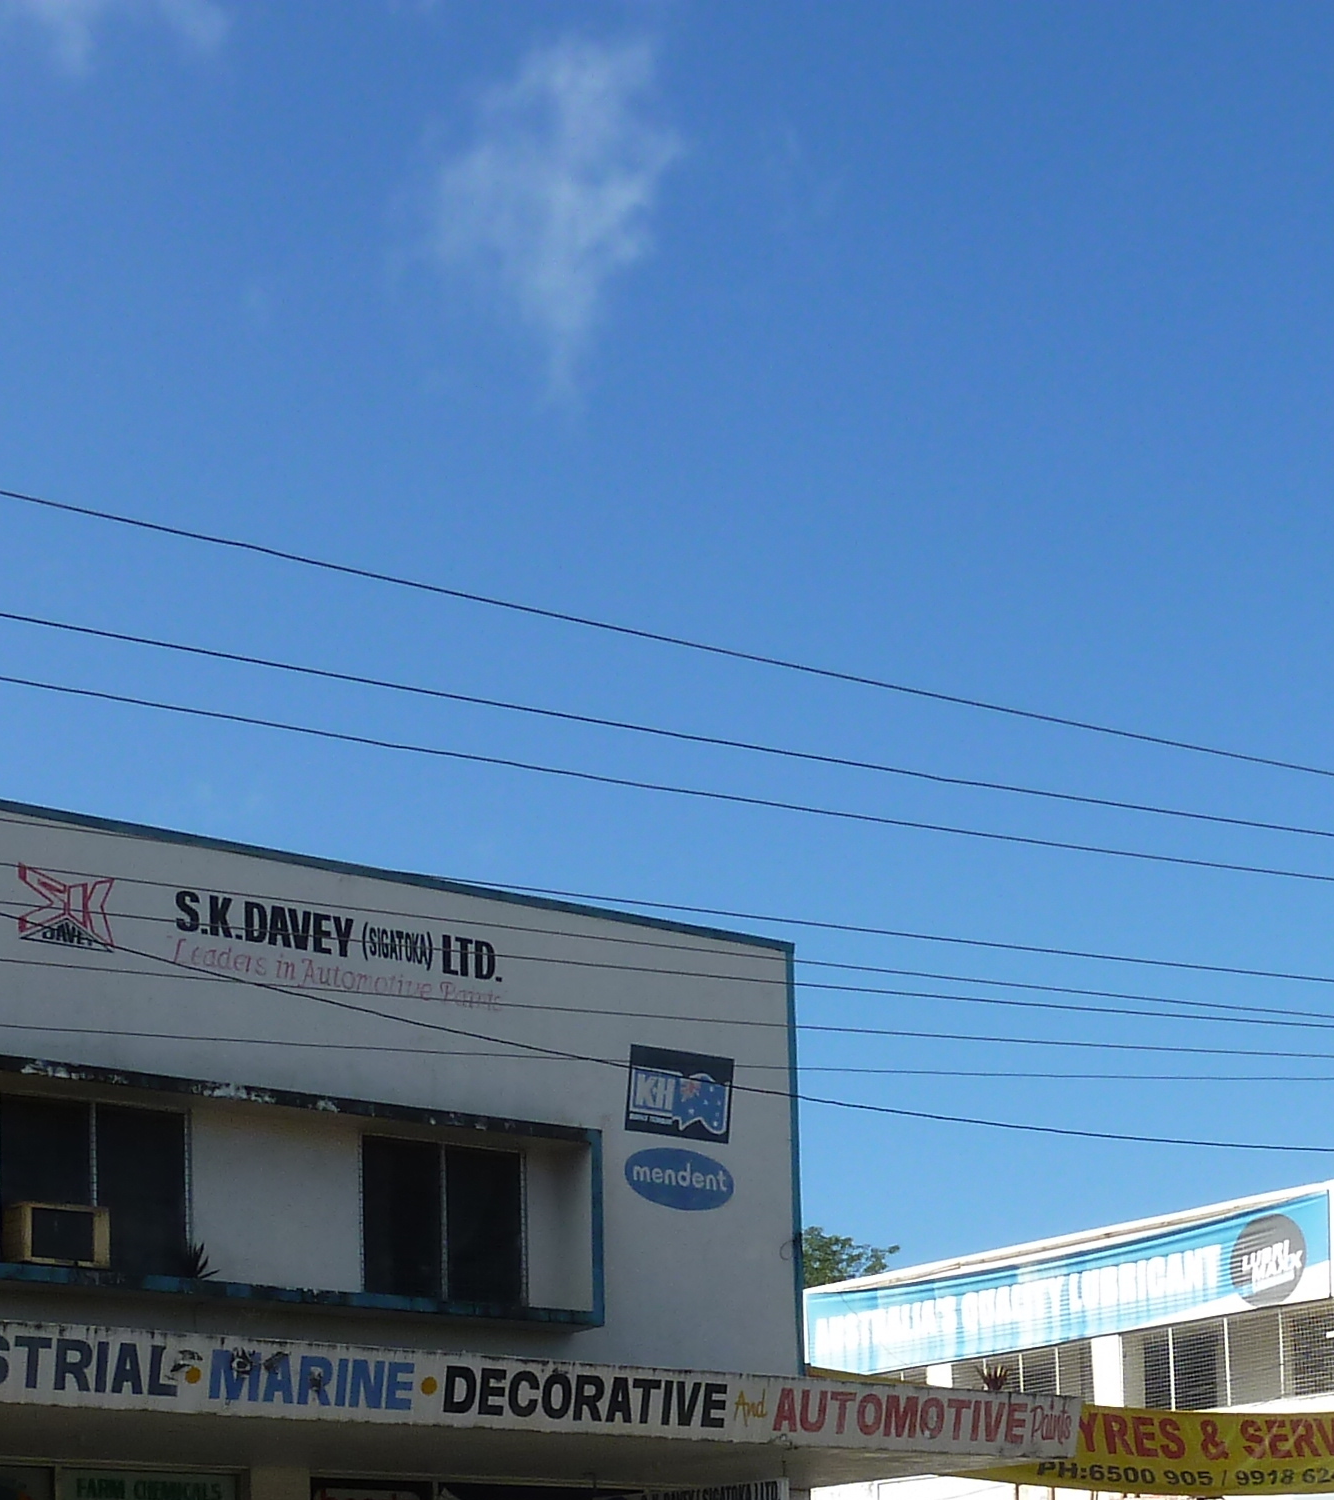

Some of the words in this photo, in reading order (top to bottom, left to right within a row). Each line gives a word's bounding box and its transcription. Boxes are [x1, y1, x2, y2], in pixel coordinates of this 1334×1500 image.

[361, 921, 434, 970] (SIGATOKA)
[442, 934, 503, 982] LTD.
[276, 953, 296, 980] in
[633, 1163, 727, 1192] mendent
[208, 1349, 415, 1411] MARINE
[442, 1365, 728, 1428] DECORATIVE
[734, 1388, 767, 1428] And
[772, 1386, 1027, 1444] AUTOMOTIVE
[1030, 1398, 1073, 1446] Paints
[1079, 1413, 1185, 1461] YRES
[1201, 1420, 1229, 1459] &
[76, 1478, 126, 1499] FARM
[1163, 1469, 1214, 1487] 905
[1235, 1468, 1295, 1486] 9918
